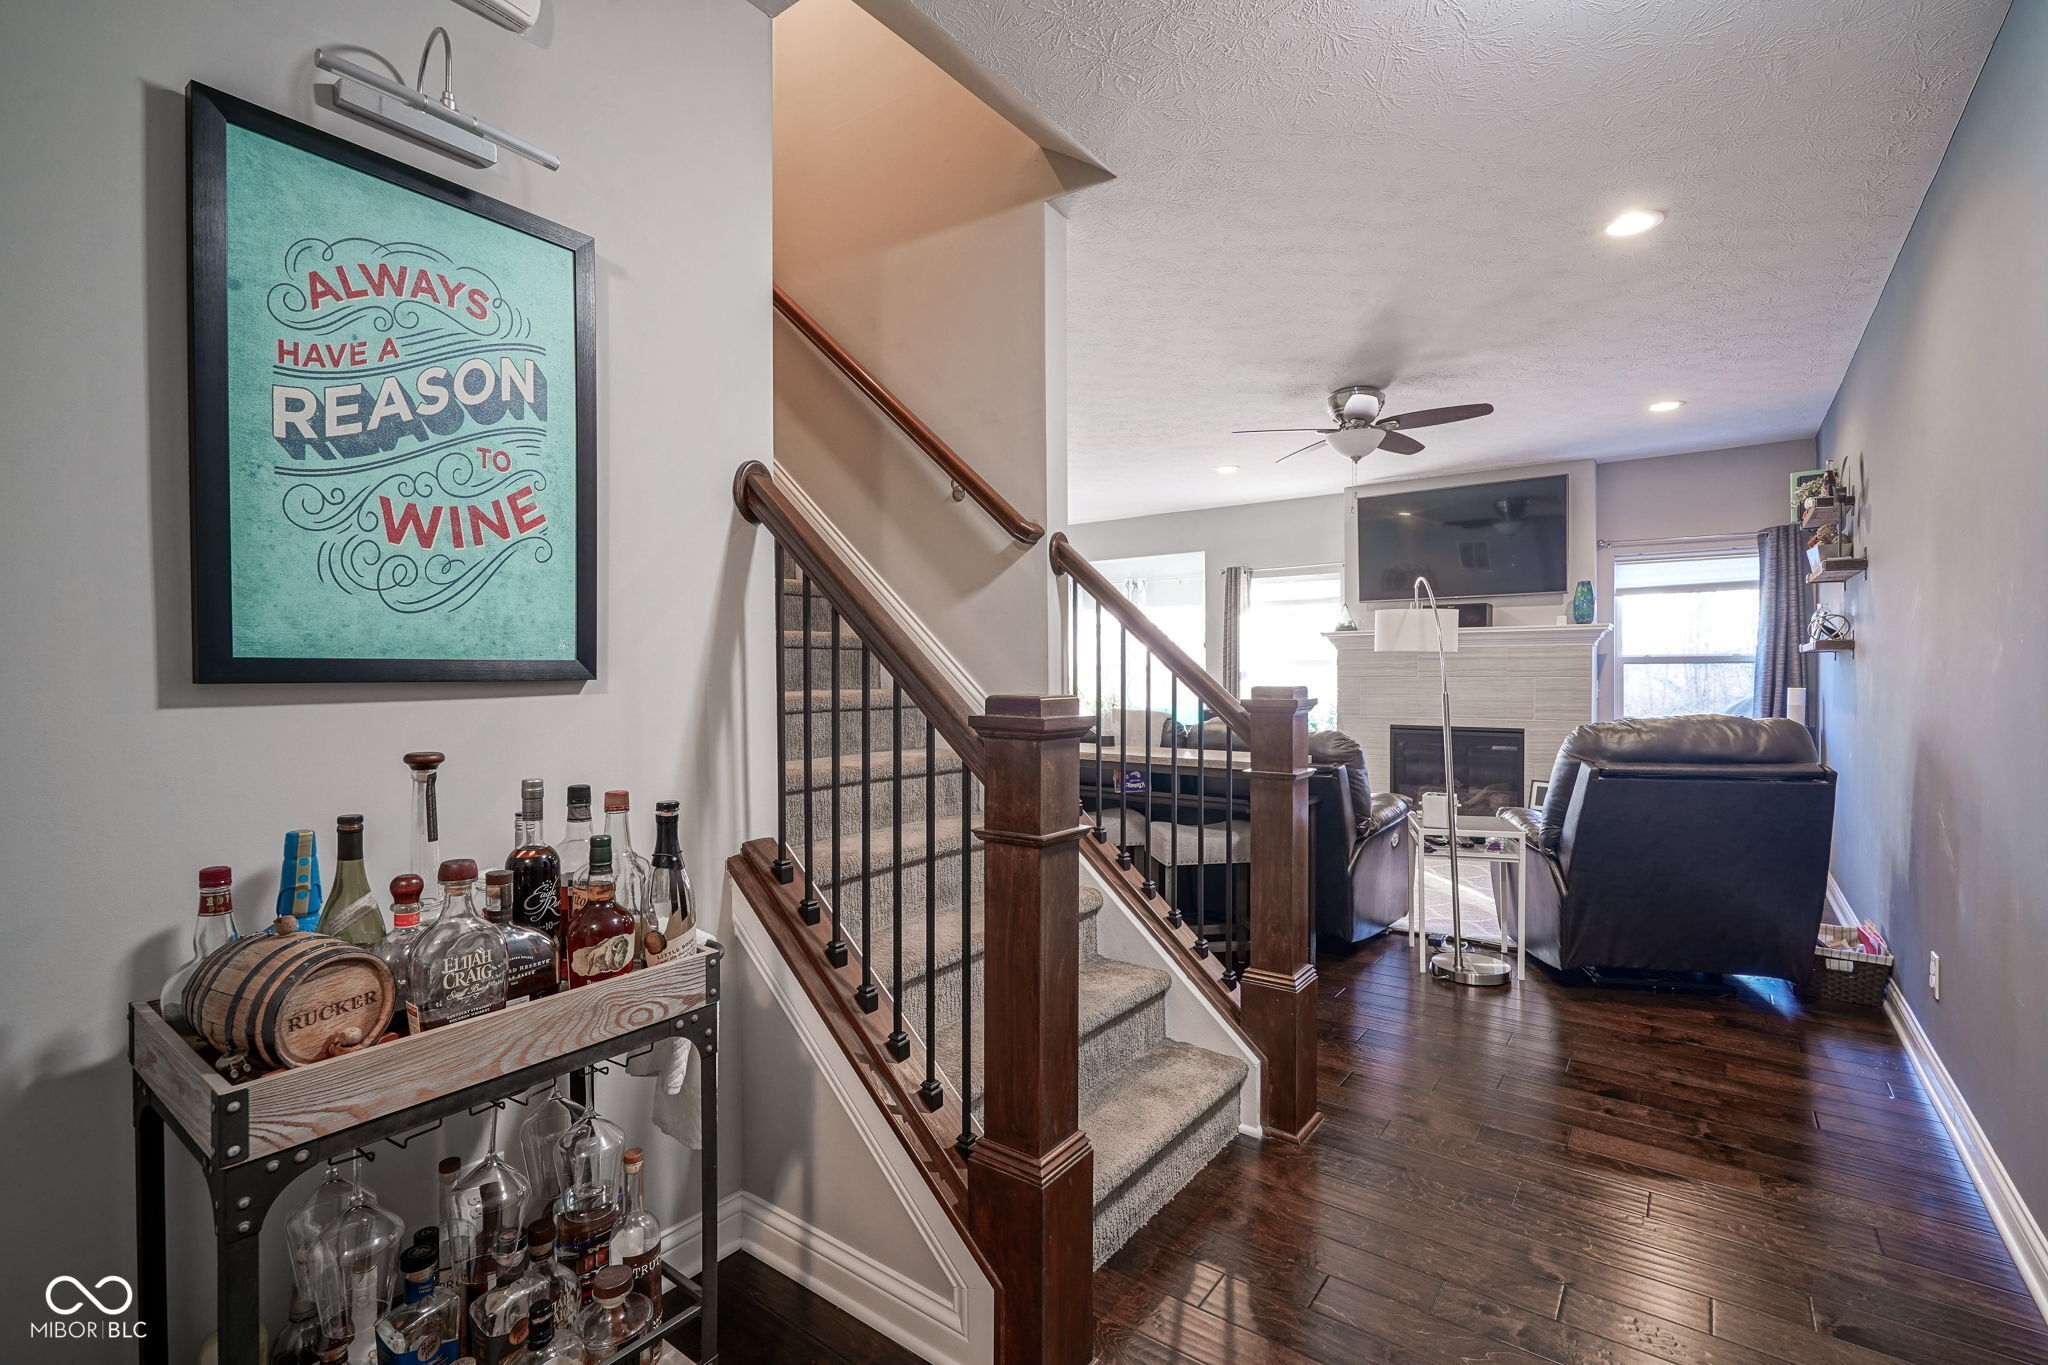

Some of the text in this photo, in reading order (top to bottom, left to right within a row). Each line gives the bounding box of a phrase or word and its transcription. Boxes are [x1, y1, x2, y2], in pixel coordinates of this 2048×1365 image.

[308, 263, 490, 321] ALWAYS
[277, 337, 400, 369] HAVE A
[272, 357, 538, 442] REASON
[476, 447, 512, 473] TO
[379, 485, 548, 550] WINE
[442, 949, 493, 974] ELIJAH
[656, 948, 681, 960] LITTLE
[443, 964, 493, 990] CRAIG
[288, 991, 378, 1033] RUCKER
